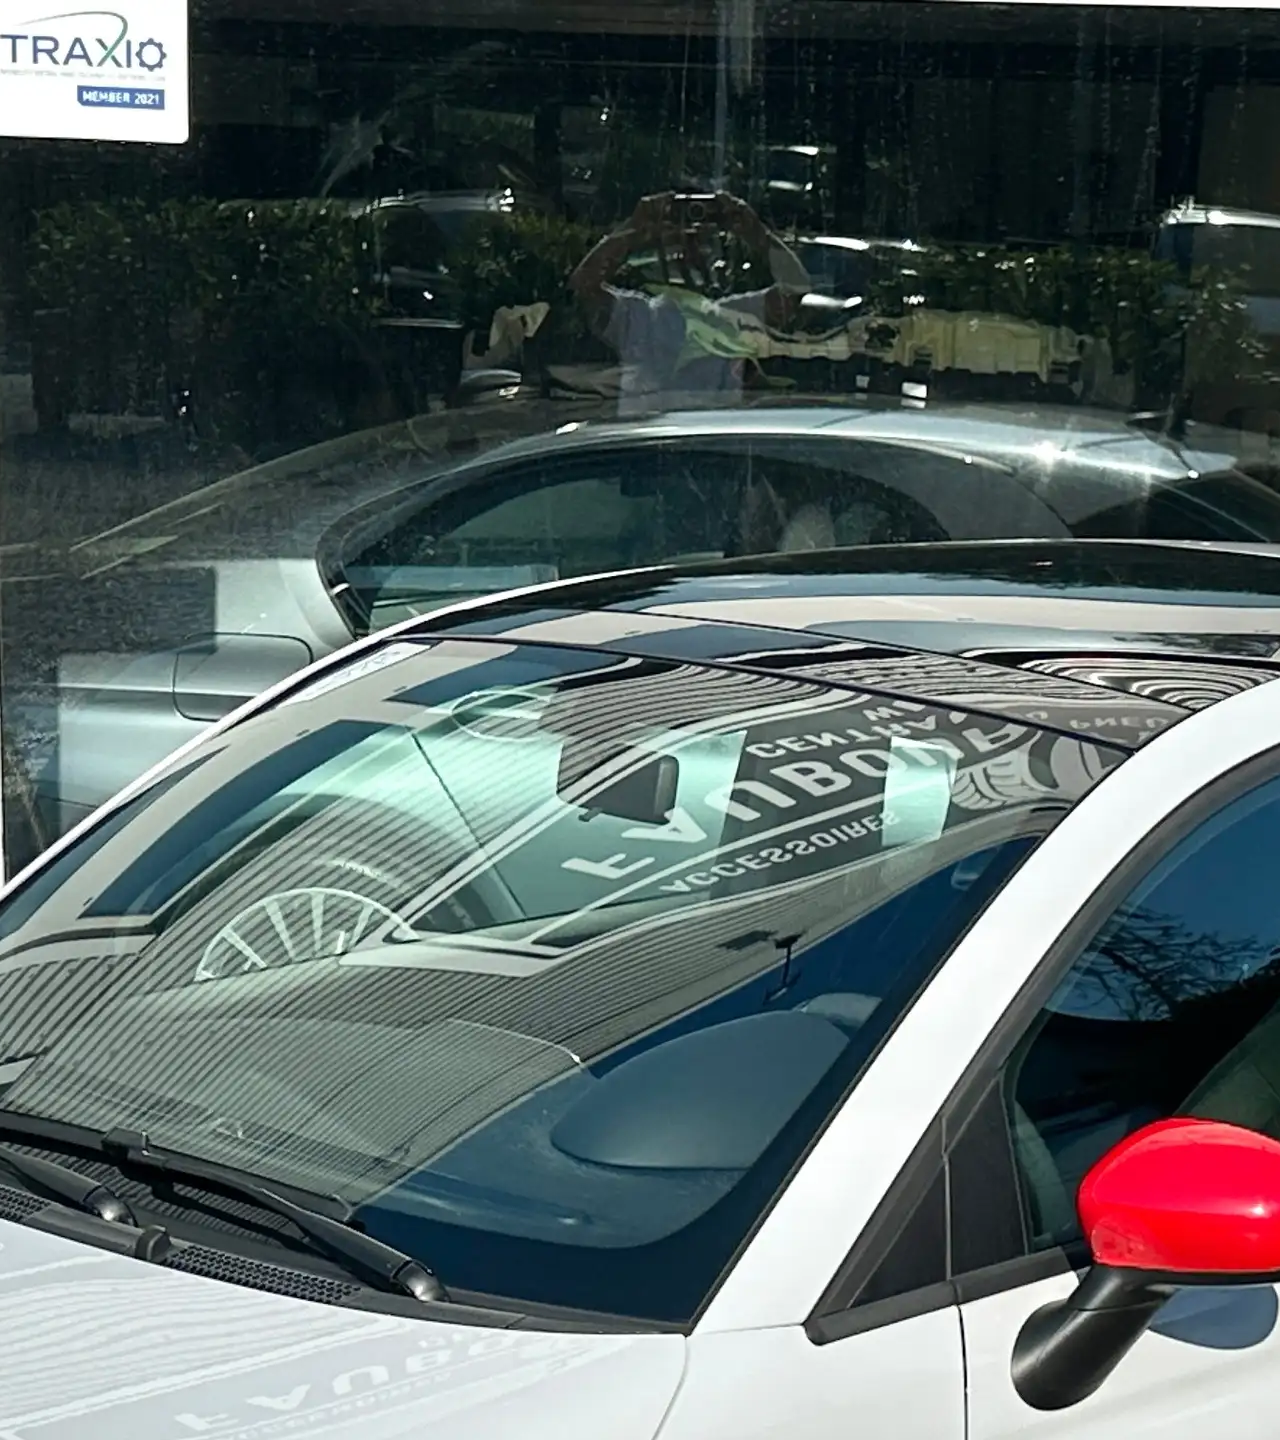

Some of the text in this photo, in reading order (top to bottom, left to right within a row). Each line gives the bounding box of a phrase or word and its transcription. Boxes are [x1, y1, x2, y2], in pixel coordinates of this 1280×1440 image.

[0, 33, 168, 73] TRAXIO
[82, 89, 160, 106] MEMBER 2021
